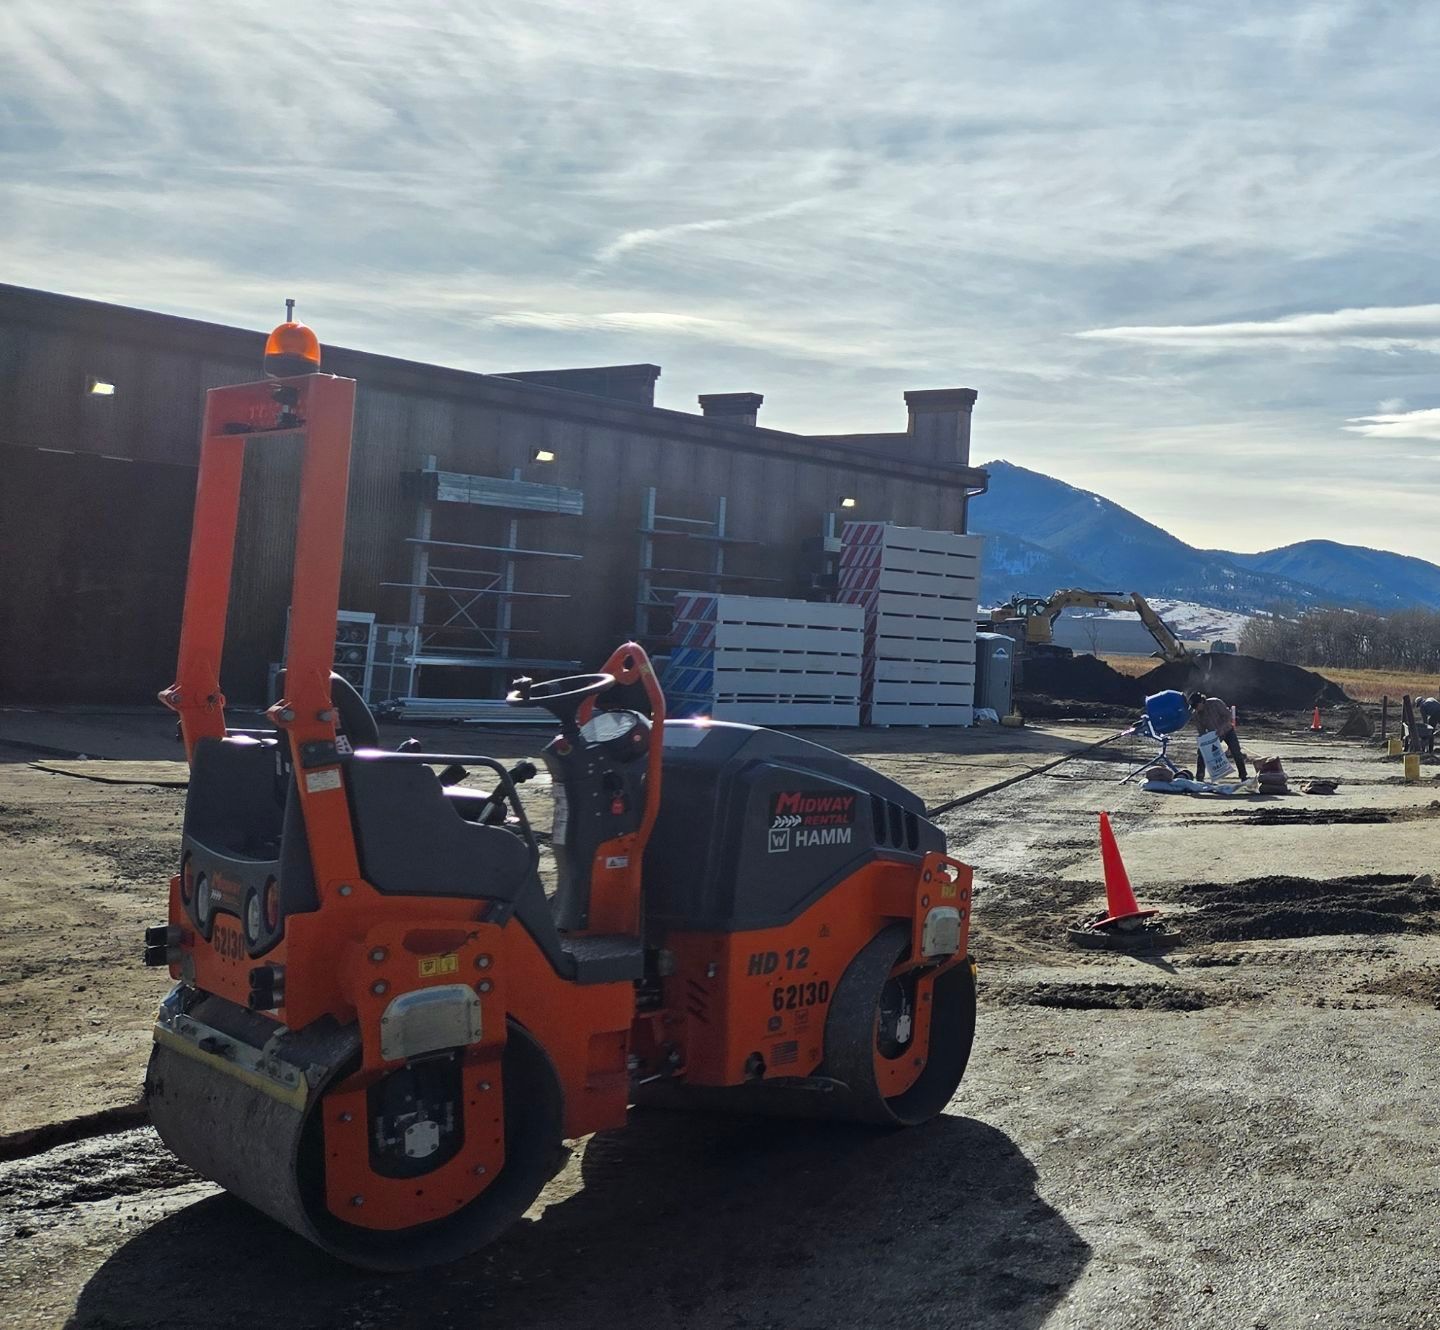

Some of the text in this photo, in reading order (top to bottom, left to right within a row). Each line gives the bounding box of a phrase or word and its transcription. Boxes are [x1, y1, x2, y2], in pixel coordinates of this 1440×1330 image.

[775, 791, 855, 815] MIDWAY
[804, 815, 849, 825] RENTAL
[795, 827, 852, 847] HAMM
[214, 925, 245, 960] 62130
[747, 947, 811, 976] HD 12
[772, 981, 830, 1011] 62130
